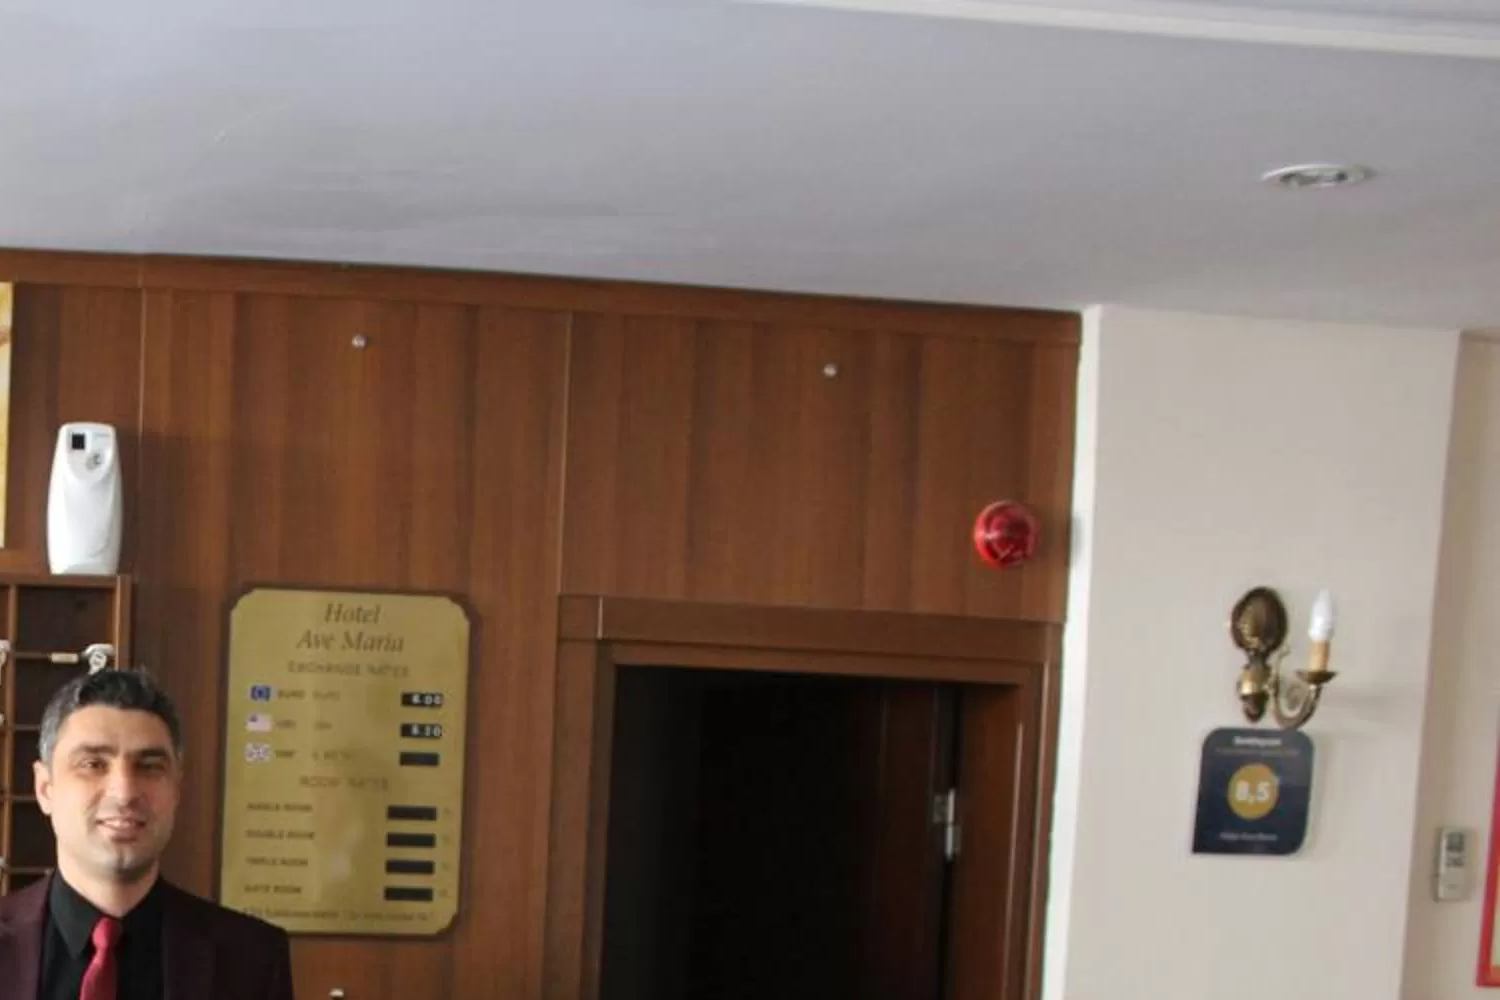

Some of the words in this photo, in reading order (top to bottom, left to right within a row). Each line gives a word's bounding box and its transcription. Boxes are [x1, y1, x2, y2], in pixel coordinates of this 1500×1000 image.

[324, 603, 382, 624] Hotel
[296, 630, 335, 650] Ave
[340, 631, 405, 652] Maria
